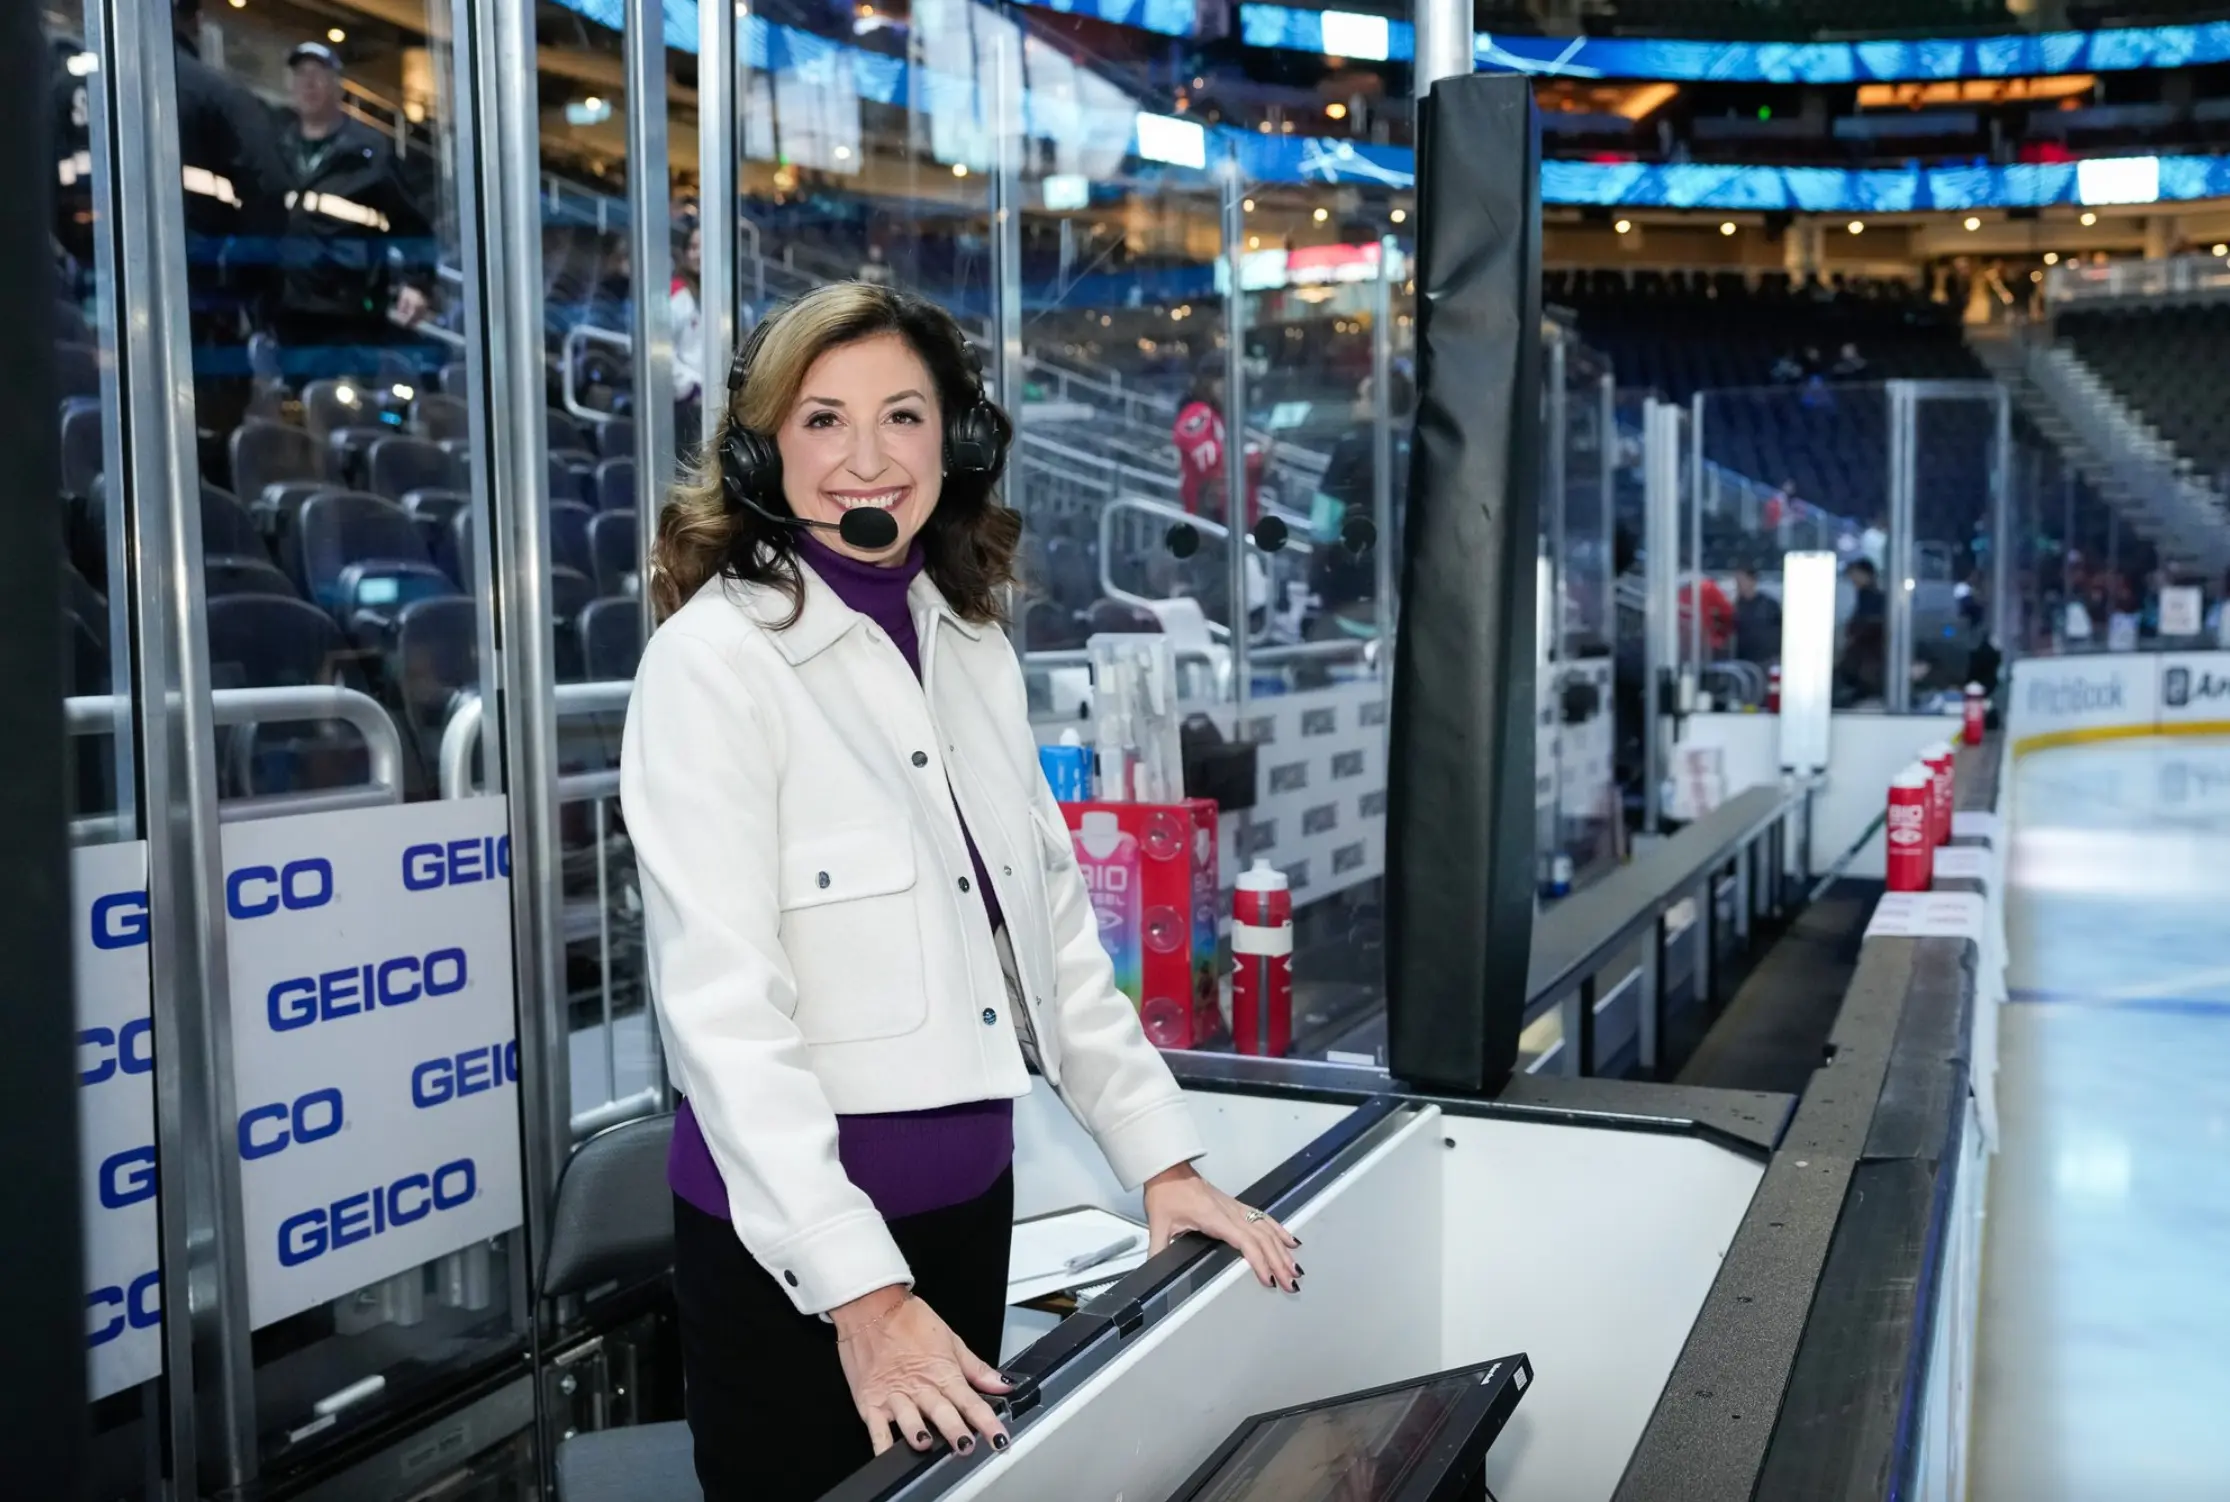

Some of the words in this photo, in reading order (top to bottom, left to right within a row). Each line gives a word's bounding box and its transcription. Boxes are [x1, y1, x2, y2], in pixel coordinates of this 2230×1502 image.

[402, 834, 510, 891] GEI
[267, 947, 468, 1032] GEICO
[412, 1039, 518, 1109] GEI
[278, 1158, 477, 1267] GEICO
